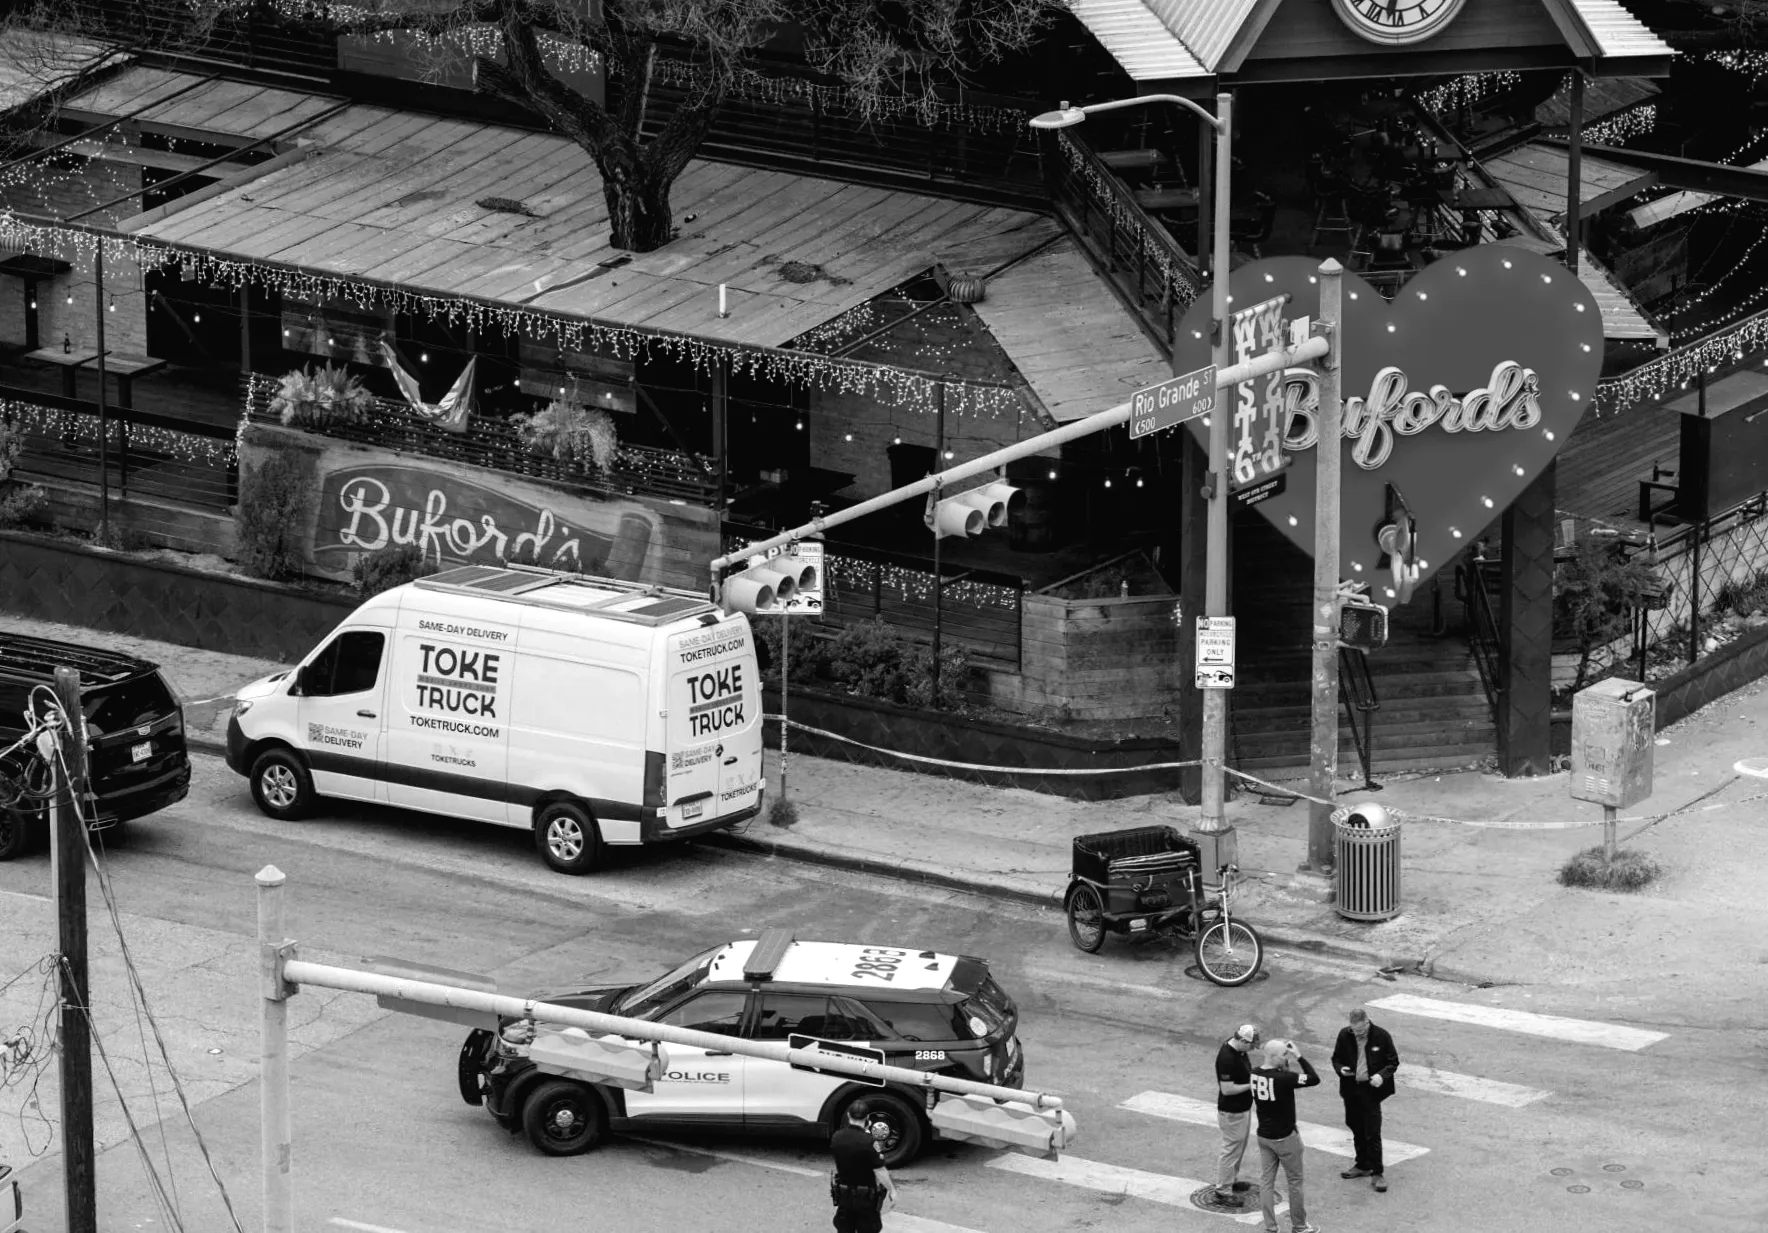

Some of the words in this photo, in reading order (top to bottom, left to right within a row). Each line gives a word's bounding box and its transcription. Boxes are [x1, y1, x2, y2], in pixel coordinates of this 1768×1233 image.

[1135, 393, 1154, 417] Rio
[1159, 377, 1200, 409] Grande
[1203, 369, 1213, 385] ST
[1193, 398, 1207, 414] 600
[1140, 417, 1155, 433] 500
[340, 476, 582, 565] Buford's
[419, 620, 466, 635] SAME-DAY
[466, 627, 508, 642] DELIVERY
[716, 625, 743, 640] DELIVERY
[1199, 618, 1209, 629] NO
[680, 638, 745, 664] TOKETRUCK.COM
[1207, 648, 1224, 656] ONLY
[420, 644, 500, 684] TOKE
[687, 664, 743, 704] TOKE
[416, 684, 496, 719] TRUCK
[410, 715, 500, 738] TOKETRUCK.COM
[689, 703, 745, 737] TRUCK
[324, 735, 363, 749] DELIVERY
[431, 754, 477, 768] TOKETRUCKS
[685, 754, 712, 767] DELIVERY
[720, 783, 758, 802] TOKETRUCKS
[915, 1050, 945, 1060] 2868
[663, 1071, 730, 1082] OLICE
[1250, 1073, 1276, 1102] FBI
